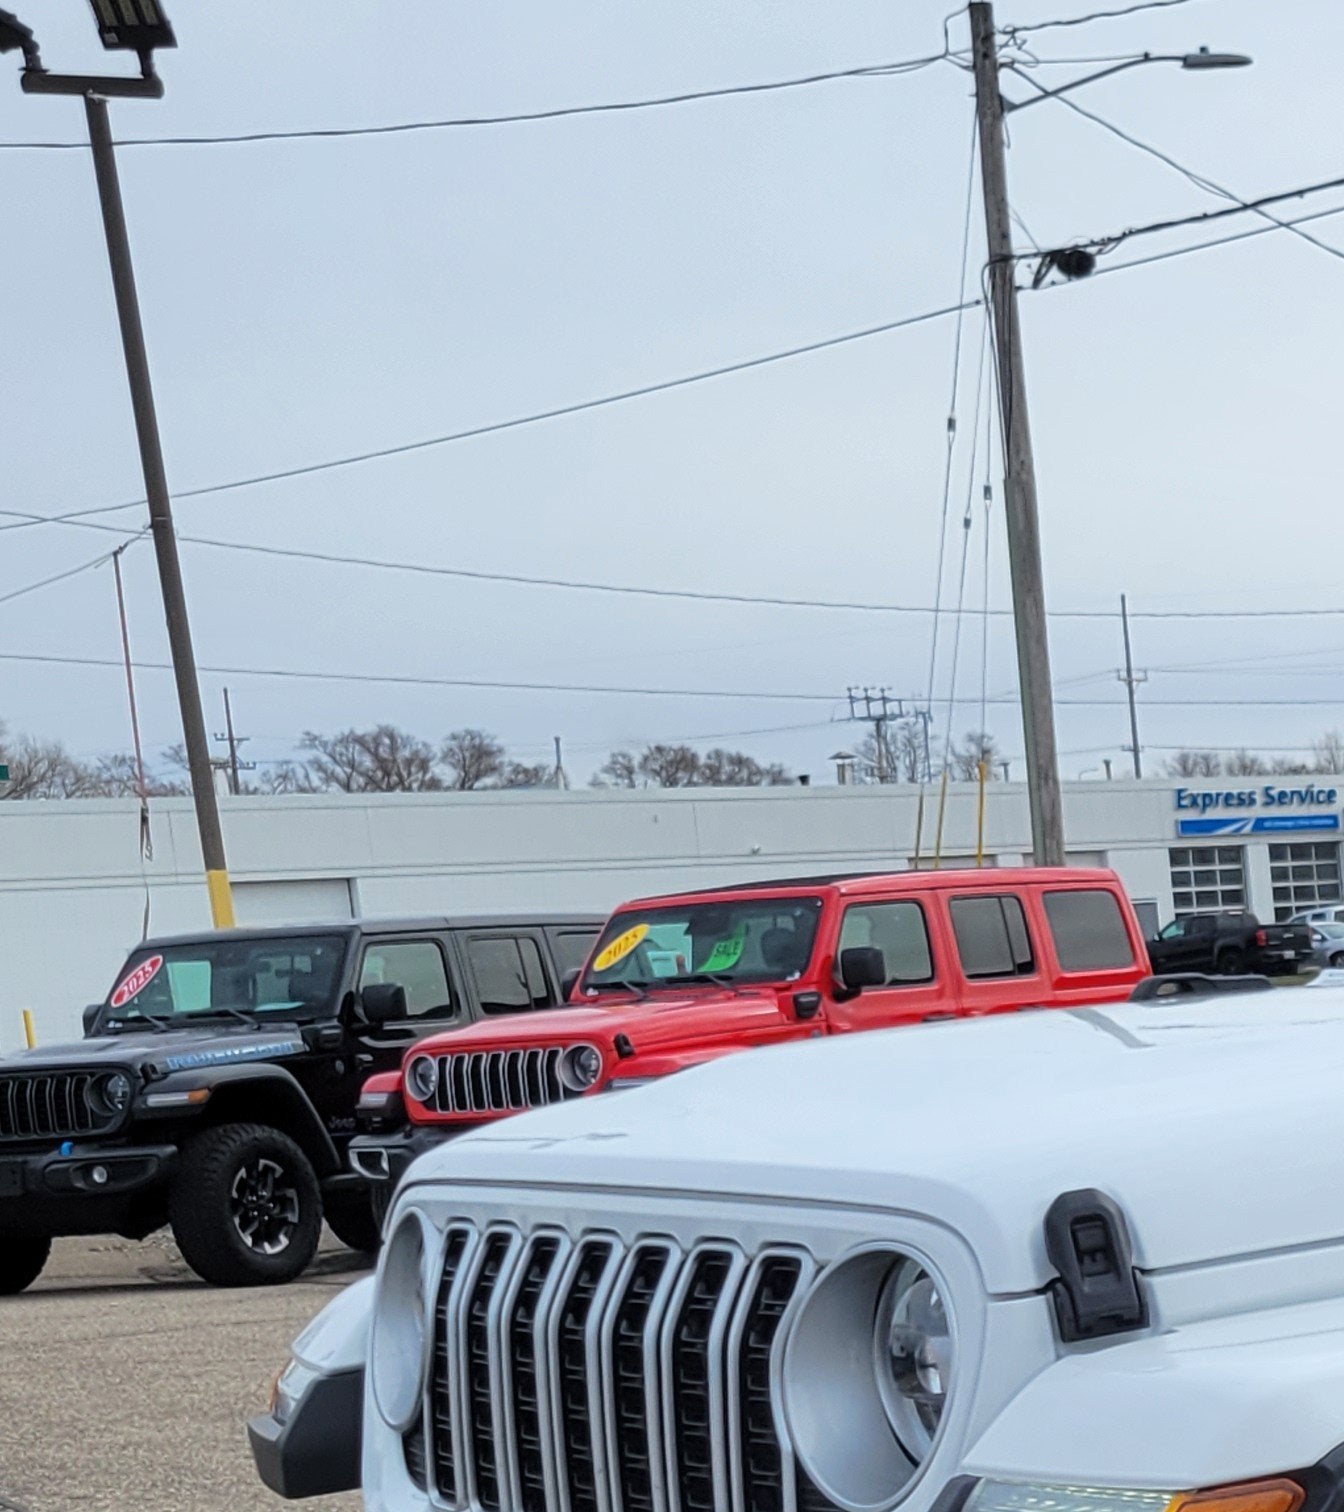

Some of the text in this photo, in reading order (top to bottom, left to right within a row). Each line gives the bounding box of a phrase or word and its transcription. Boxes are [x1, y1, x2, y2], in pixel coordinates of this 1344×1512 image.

[1175, 783, 1338, 815] Express Service
[604, 931, 638, 966] 2025
[714, 939, 742, 958] SALE
[121, 963, 153, 1000] 2025
